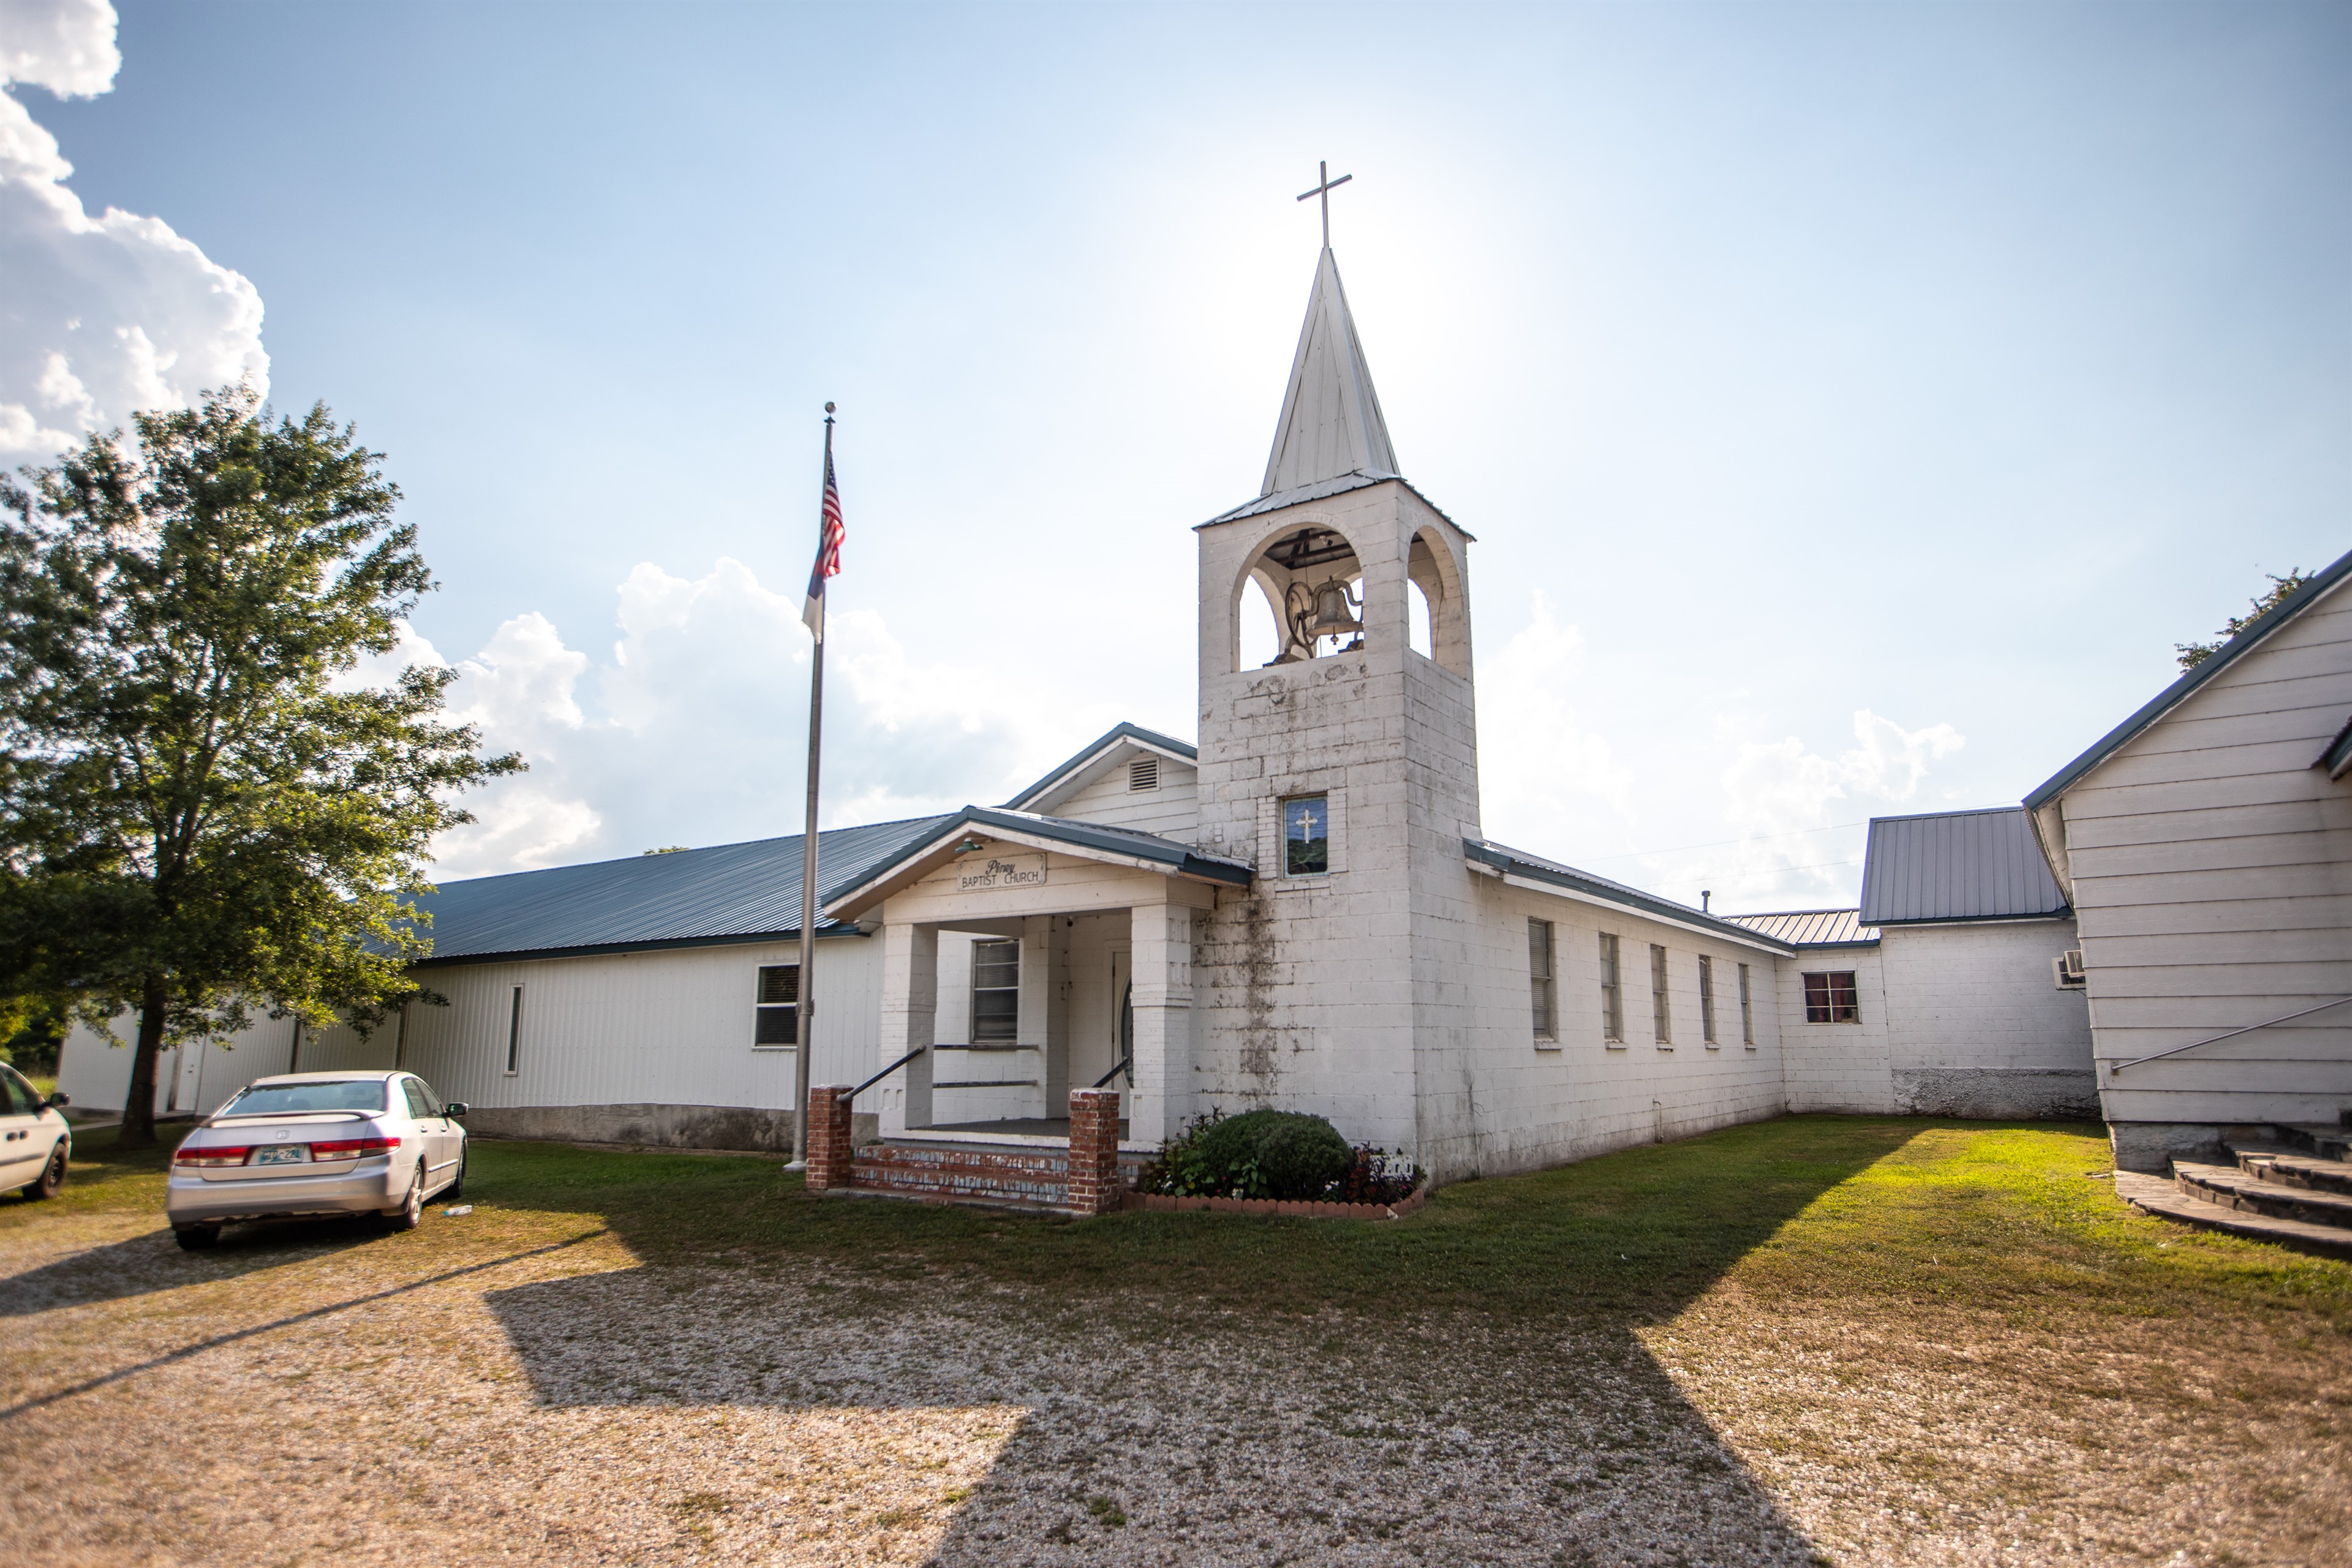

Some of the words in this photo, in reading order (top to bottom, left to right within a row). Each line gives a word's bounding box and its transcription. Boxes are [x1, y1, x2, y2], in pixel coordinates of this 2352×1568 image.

[986, 859, 1016, 875] Piney
[962, 875, 997, 888] BAPTIST
[1005, 871, 1039, 884] CHURCH
